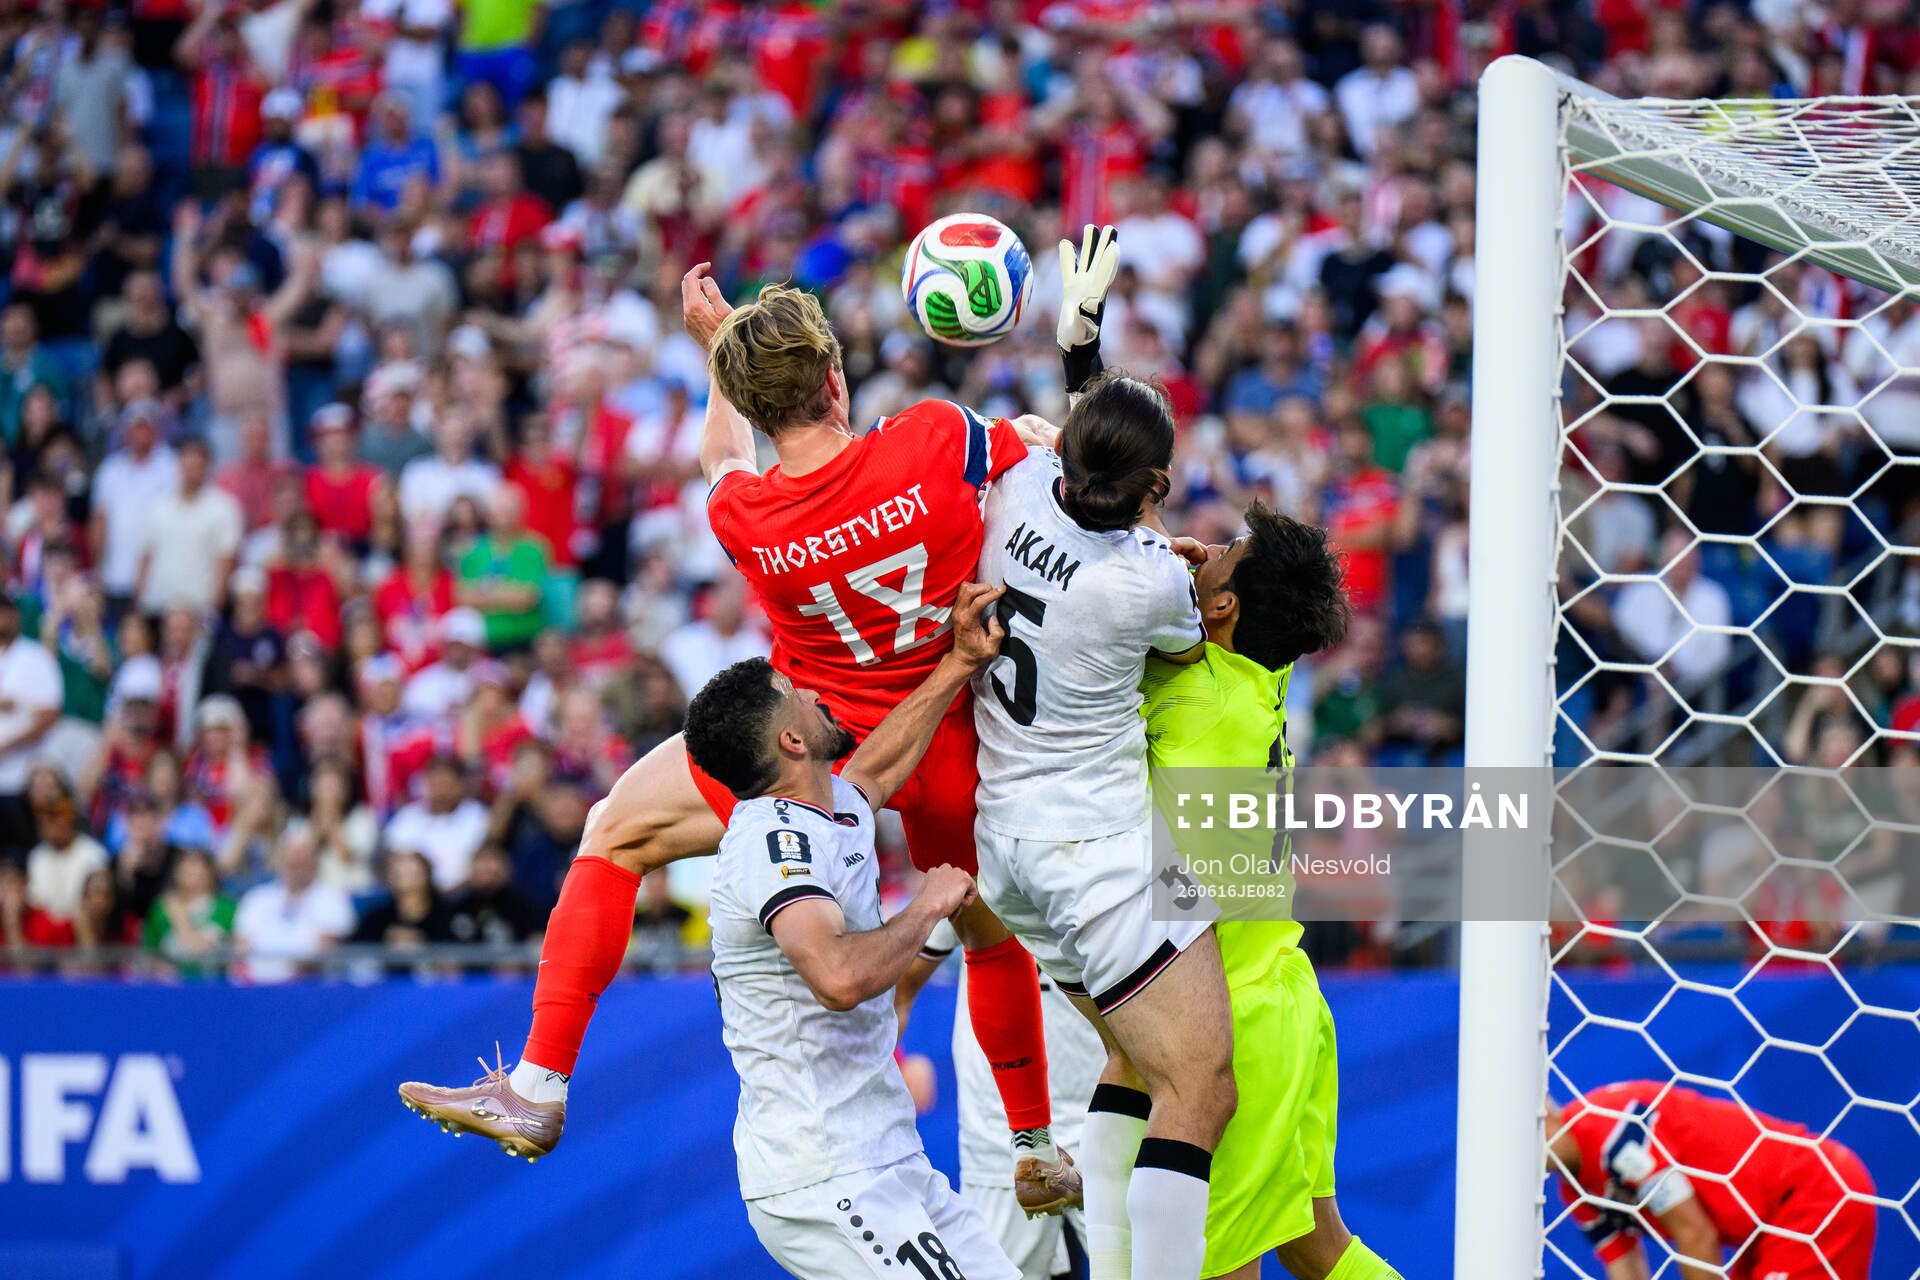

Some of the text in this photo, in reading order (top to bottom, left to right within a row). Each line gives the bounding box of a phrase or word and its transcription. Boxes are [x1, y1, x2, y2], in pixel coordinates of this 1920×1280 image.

[752, 483, 929, 576] THORSTVEDT
[1004, 522, 1081, 592] AKAM
[797, 542, 954, 667] 18
[990, 578, 1047, 727] 5
[842, 852, 865, 868] JAKO
[895, 1231, 967, 1280] 18
